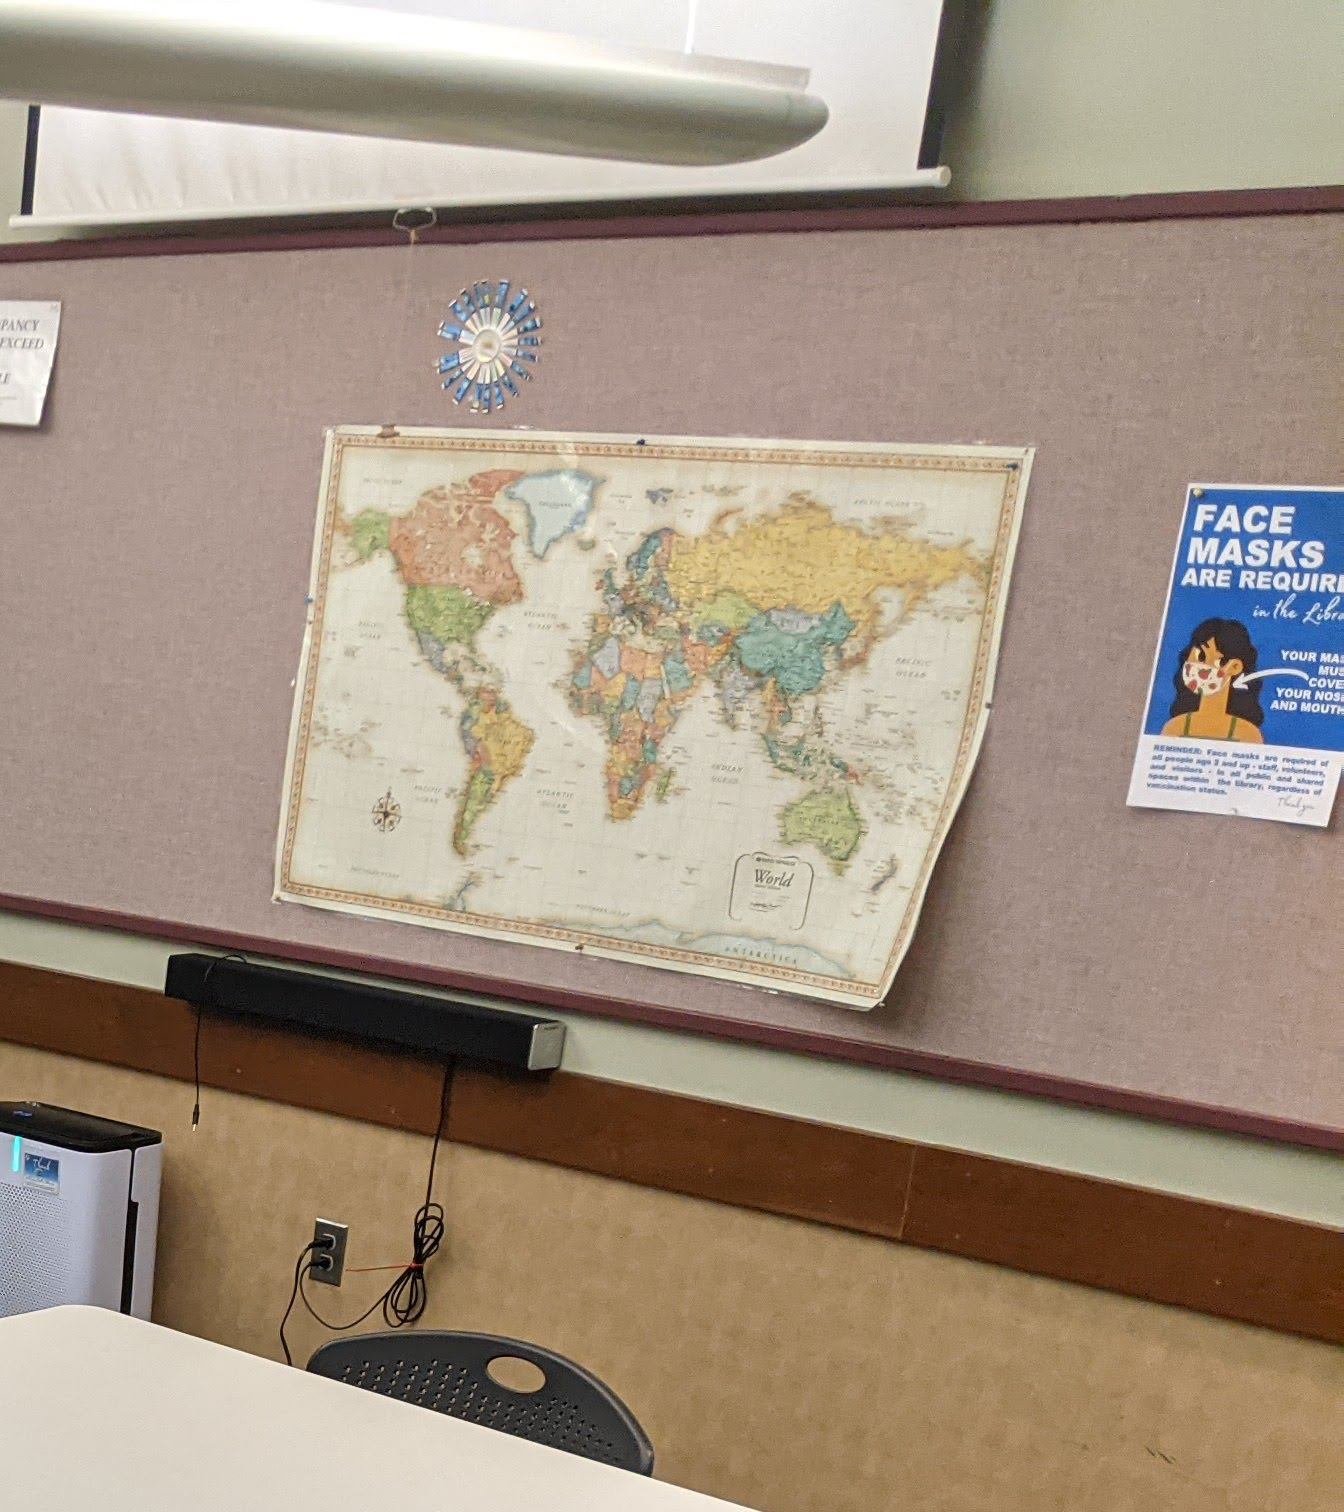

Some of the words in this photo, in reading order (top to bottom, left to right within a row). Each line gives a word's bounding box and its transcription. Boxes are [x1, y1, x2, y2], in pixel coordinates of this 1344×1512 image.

[0, 338, 44, 350] EXCEED
[1193, 504, 1296, 534] FACE
[1186, 537, 1325, 569] MASKS
[1180, 567, 1232, 587] ARE
[1253, 605, 1270, 617] in
[1273, 593, 1298, 620] the
[1281, 649, 1317, 662] YOUR
[1276, 687, 1311, 700] YOUR
[1270, 699, 1297, 711] AND
[1165, 756, 1193, 764] people
[1207, 749, 1228, 757] Face
[1232, 752, 1259, 760] masks
[1282, 757, 1316, 766] required
[1172, 765, 1203, 774] visitors
[1297, 778, 1324, 786] shared
[1268, 784, 1310, 795] regardless
[755, 869, 795, 888] World
